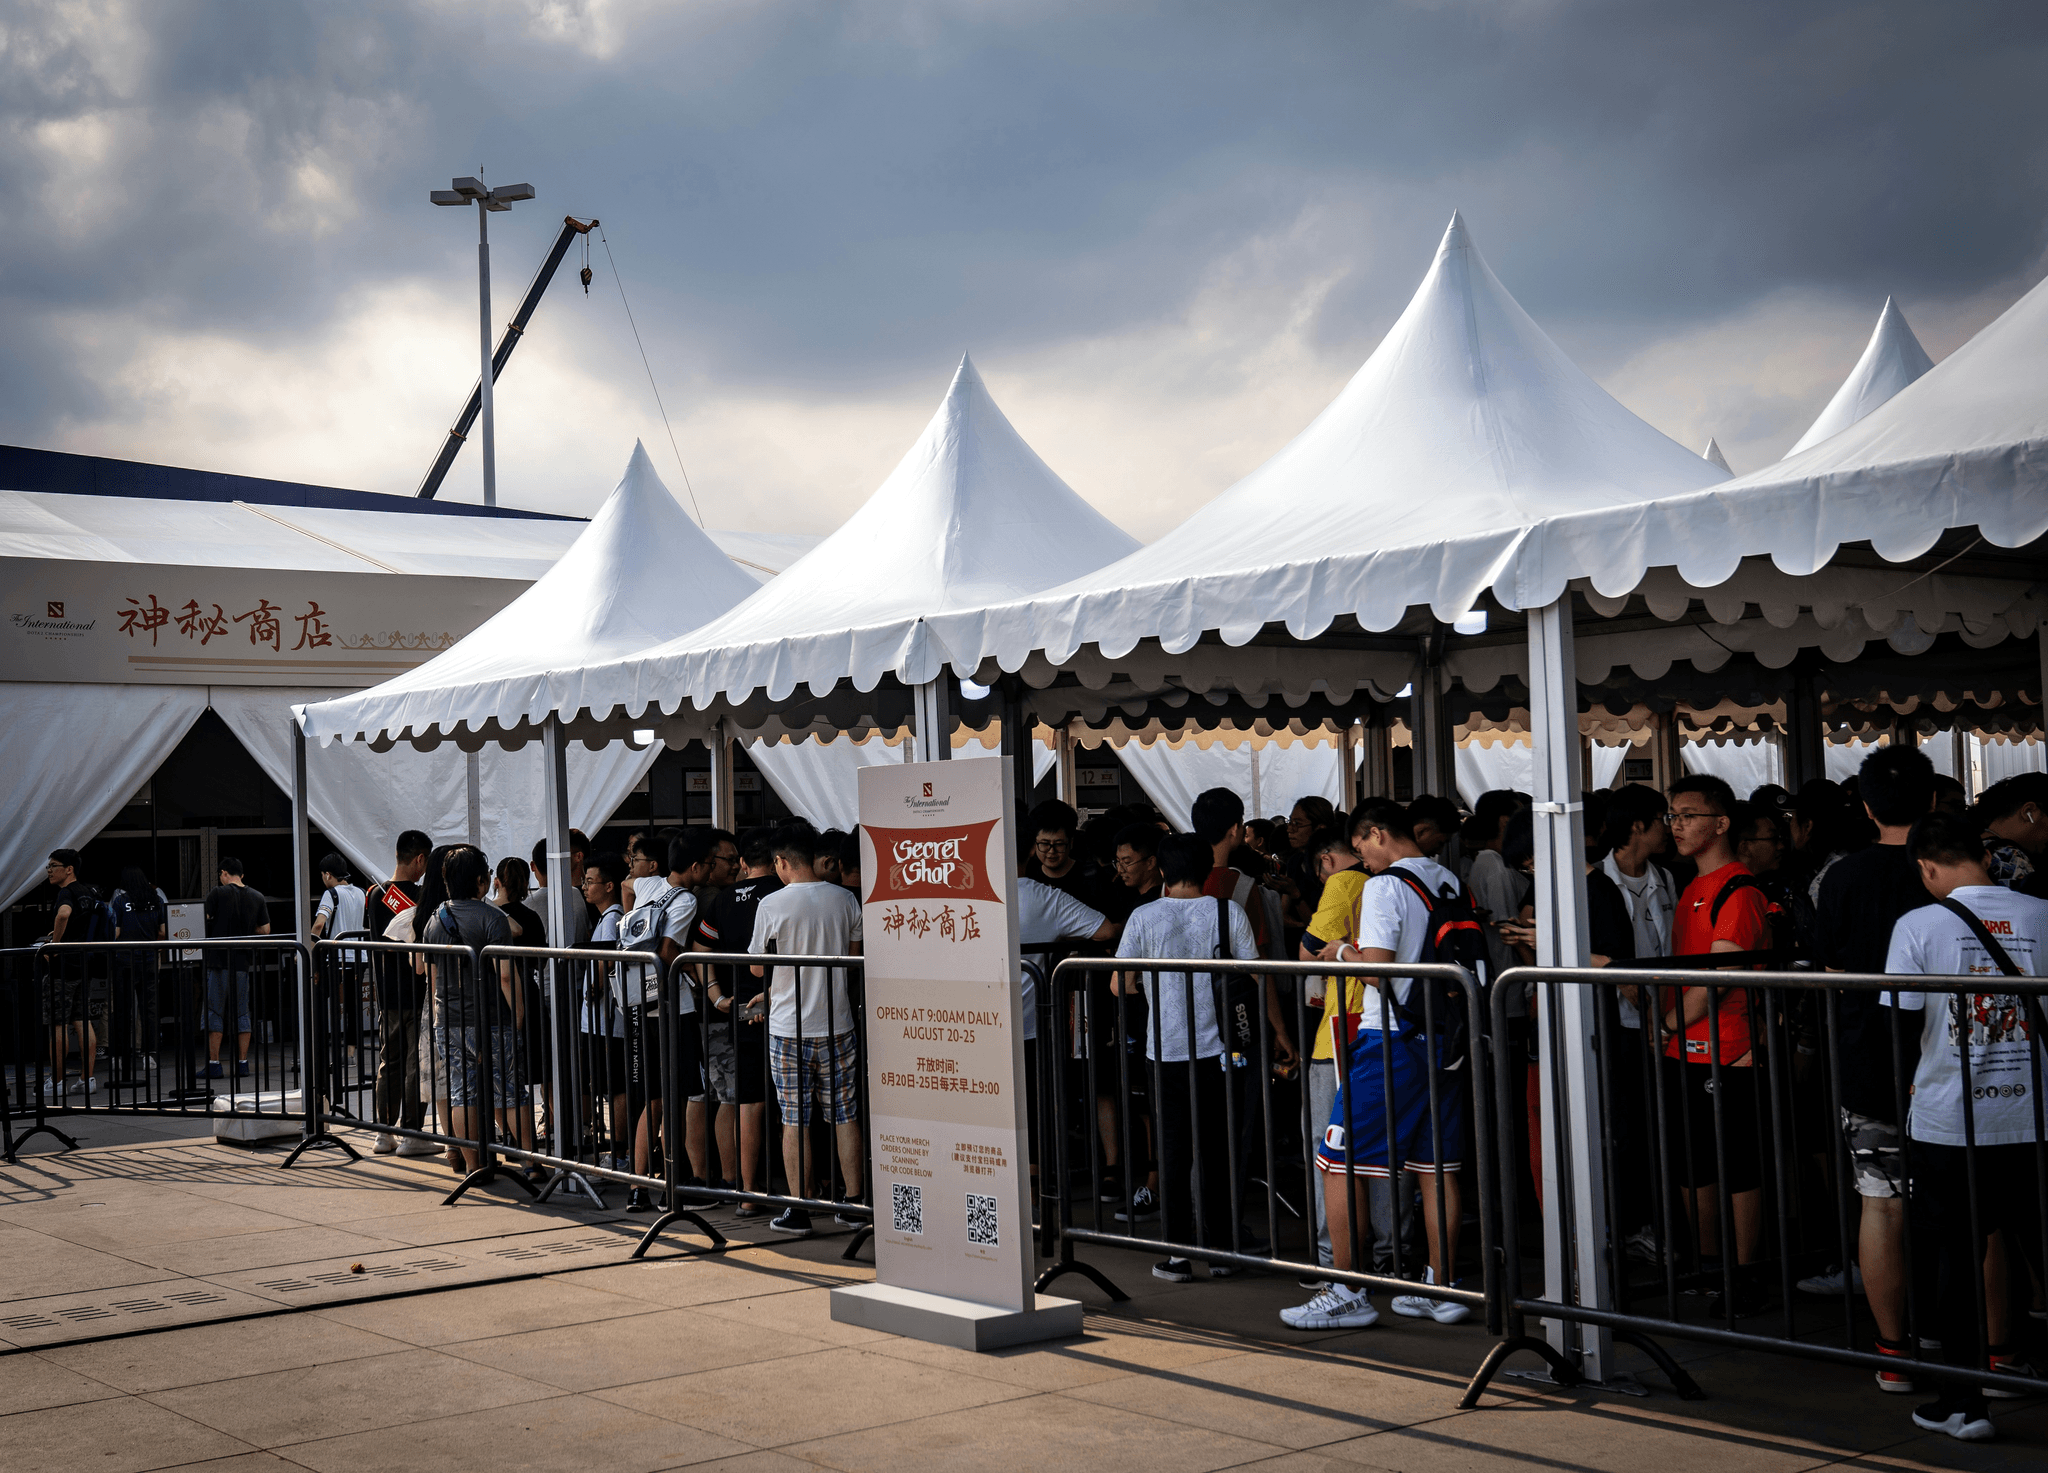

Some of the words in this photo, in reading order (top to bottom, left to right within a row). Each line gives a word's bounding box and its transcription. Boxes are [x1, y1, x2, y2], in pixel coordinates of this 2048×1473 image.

[15, 613, 96, 631] International
[117, 594, 333, 653] 神秘商店
[1082, 770, 1095, 784] 12
[907, 795, 951, 808] International
[387, 894, 401, 911] WE
[735, 893, 752, 903] BOY
[882, 904, 982, 943] 神秘商店
[876, 1006, 909, 1021] OPENS
[911, 1008, 925, 1022] AT
[927, 1009, 966, 1024] 9:00AM
[968, 1011, 1003, 1028] DAILY,
[903, 1026, 945, 1041] AUGUST
[947, 1029, 975, 1043] 20-25
[881, 1072, 1000, 1095] 8月20日-25日每天早上9:00
[879, 1134, 895, 1143] PLACE
[895, 1135, 911, 1144] YOUR
[911, 1137, 930, 1147] MERCH
[881, 1144, 902, 1154] ORDERS
[902, 1146, 922, 1156] ONLINE
[922, 1149, 929, 1157] BY
[892, 1155, 919, 1166] SCANNING
[880, 1164, 890, 1172] THE
[890, 1165, 899, 1174] QR
[899, 1166, 914, 1176] CODE
[914, 1168, 932, 1178] BELOW
